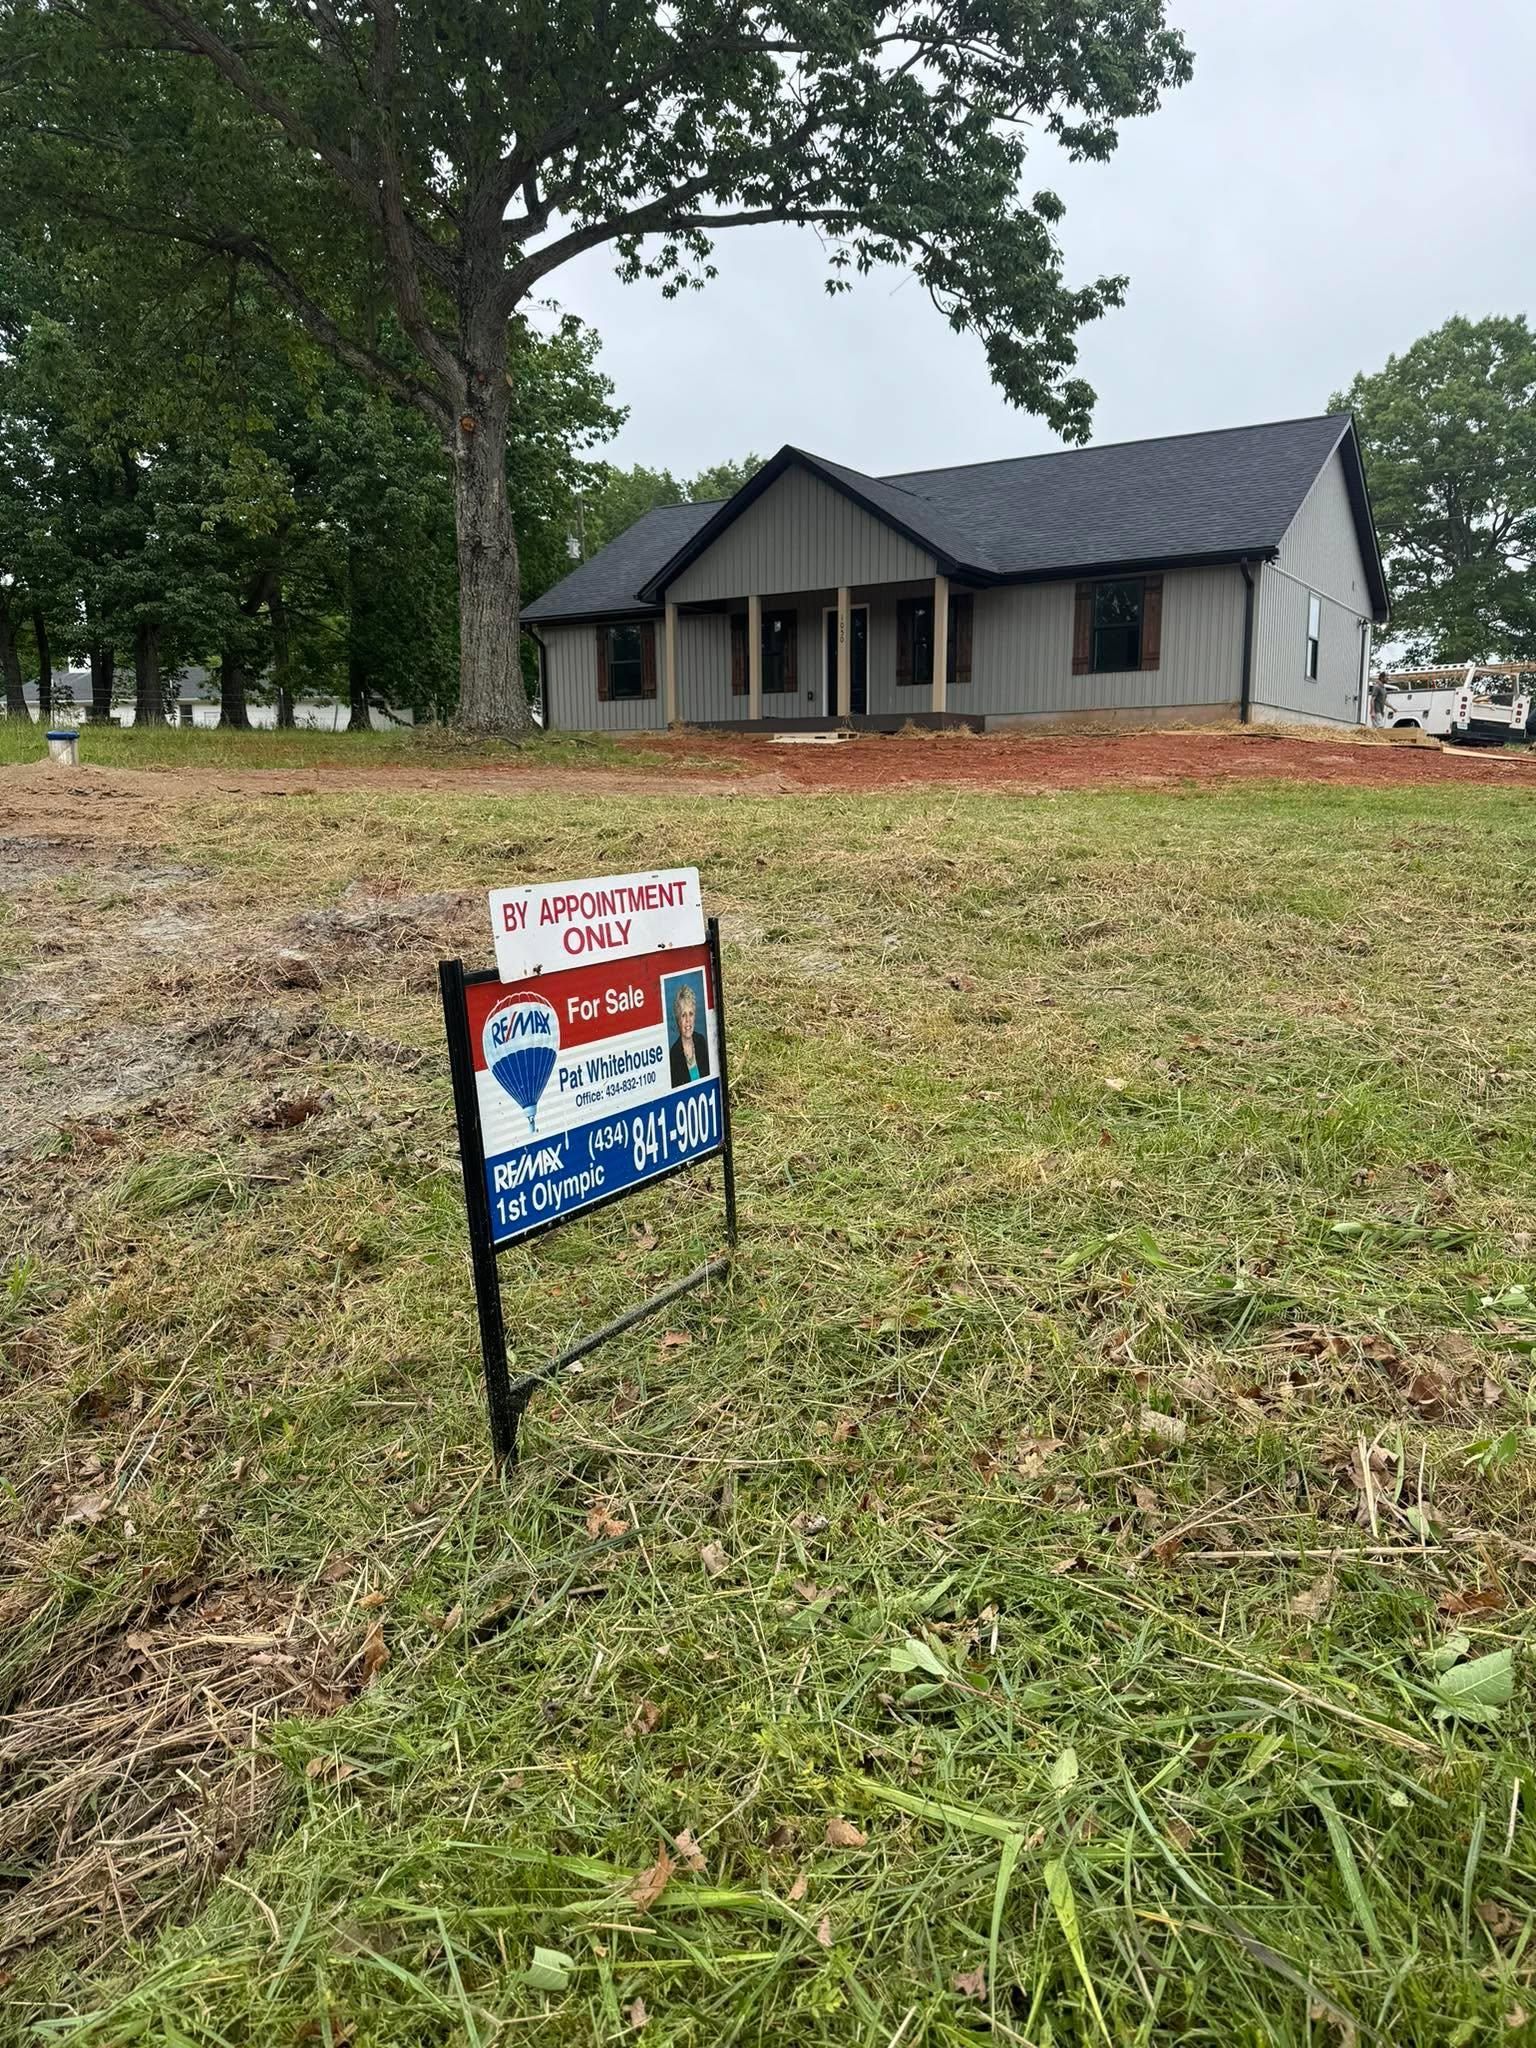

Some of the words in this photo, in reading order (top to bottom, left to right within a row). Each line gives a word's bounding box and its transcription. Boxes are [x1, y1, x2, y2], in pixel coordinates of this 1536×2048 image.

[503, 901, 528, 932] BY
[540, 881, 687, 926] APPOINTMENT
[563, 919, 632, 955] ONLY
[567, 997, 601, 1024] For
[605, 985, 645, 1015] Sale
[491, 1011, 552, 1048] RE/MAX
[559, 1064, 584, 1092] Pat
[586, 1045, 663, 1083] Whitehouse
[575, 1090, 604, 1107] Office:
[605, 1071, 656, 1098] 434-832-1100
[588, 1119, 629, 1161] (434)
[632, 1088, 718, 1171] 841-9001
[493, 1143, 564, 1194] RE/MAX
[496, 1197, 528, 1225] 1st
[532, 1162, 605, 1211] Olympic
